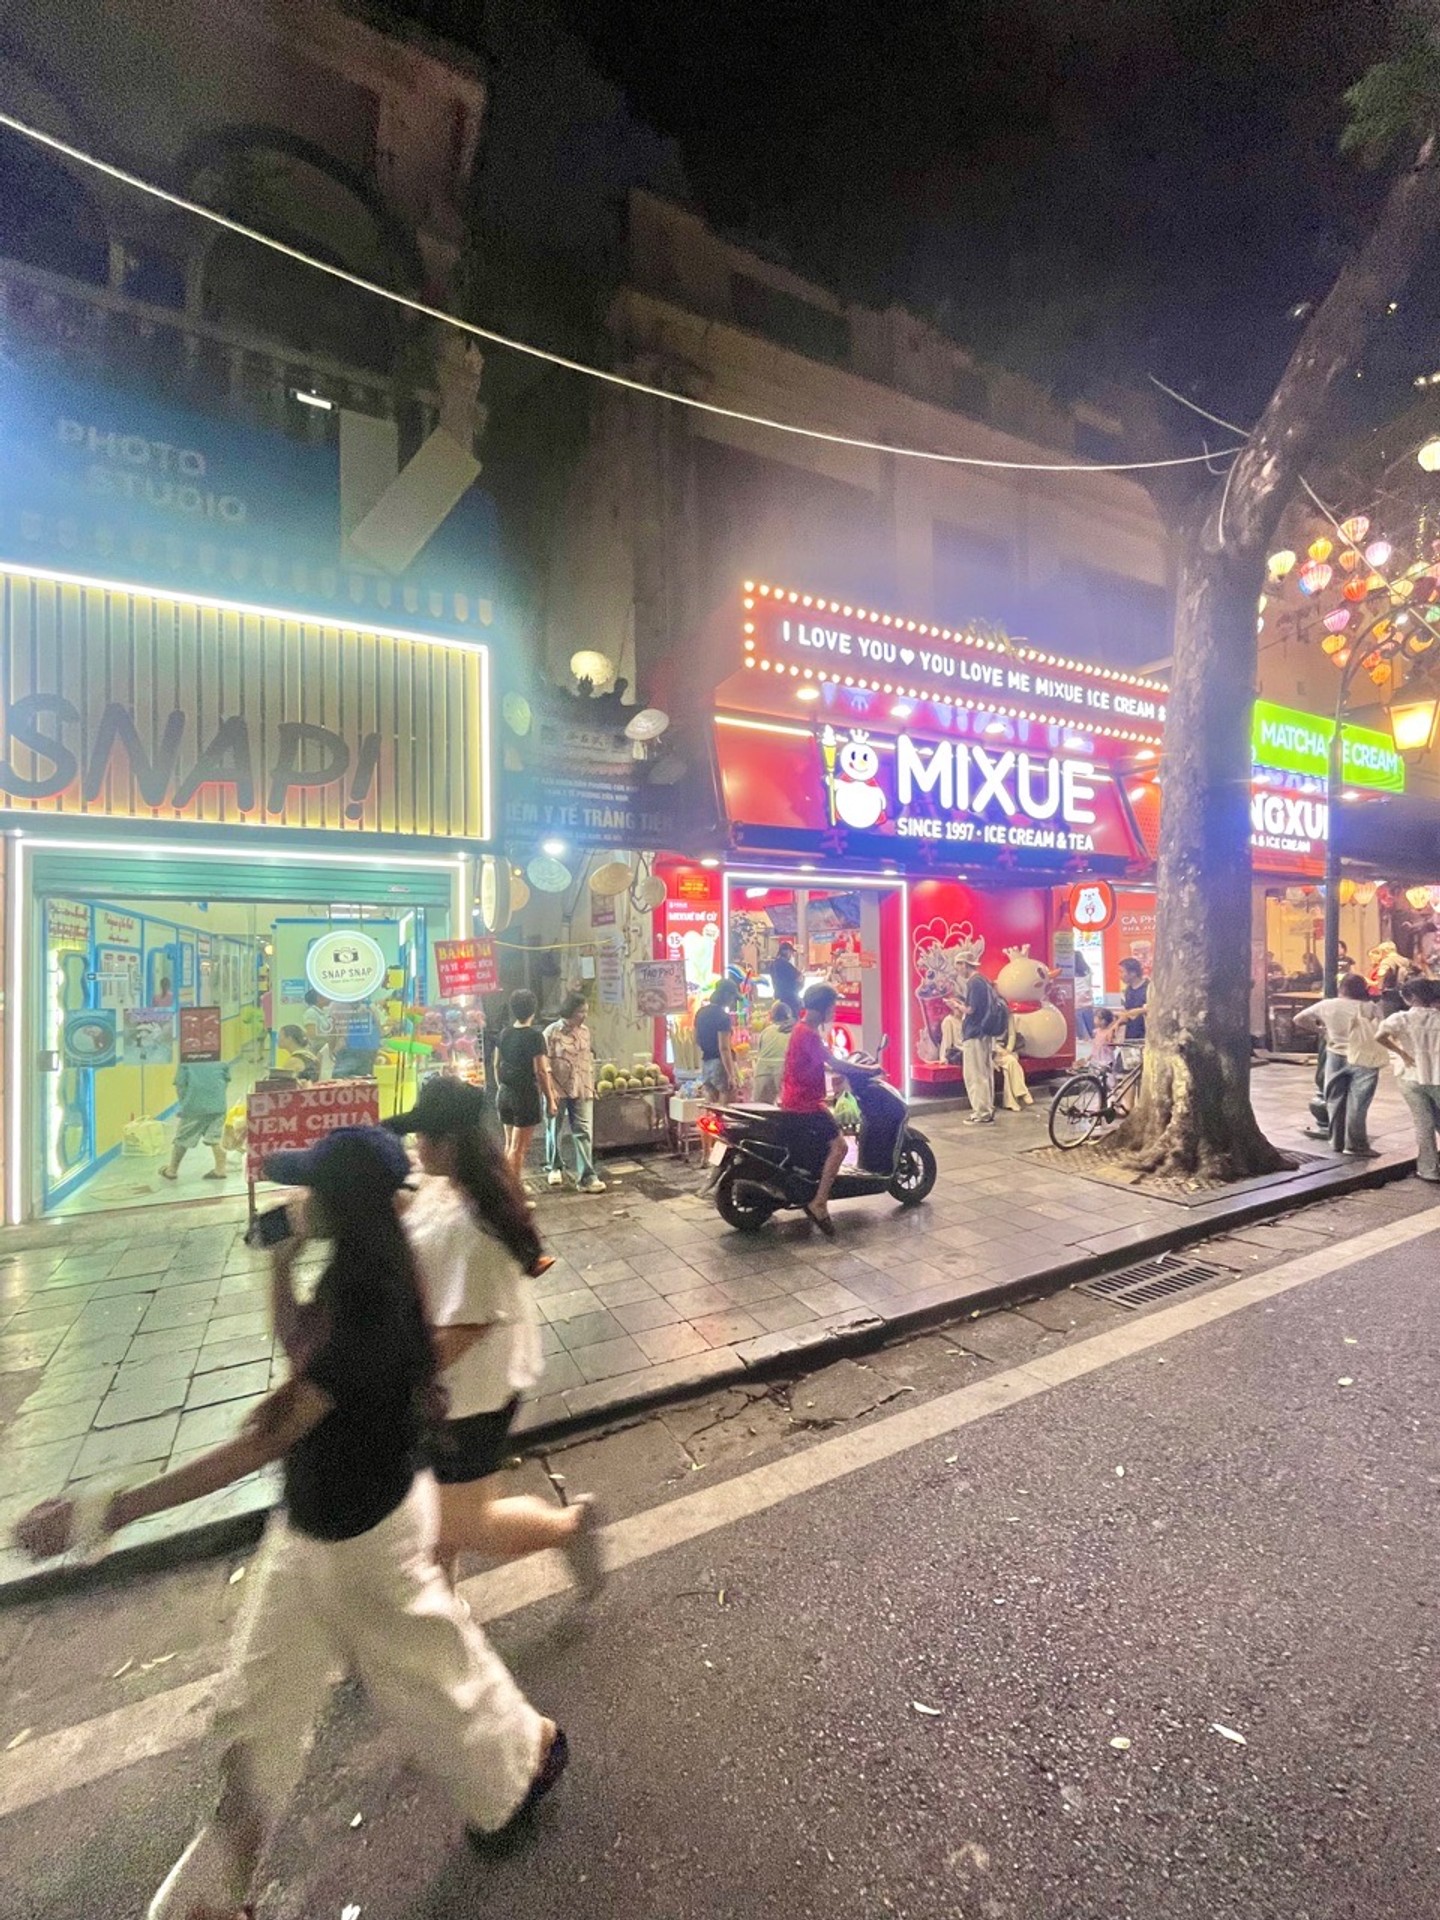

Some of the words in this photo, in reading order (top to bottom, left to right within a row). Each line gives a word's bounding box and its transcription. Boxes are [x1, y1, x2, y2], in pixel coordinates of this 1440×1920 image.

[57, 416, 206, 476] PHOTO
[88, 464, 247, 522] STUDIO
[783, 620, 791, 642] I
[799, 624, 852, 655] LOVE
[858, 636, 897, 663] YOU
[919, 651, 955, 677] YOU
[960, 660, 1004, 687] LOVE
[1008, 670, 1030, 692] ME
[1035, 677, 1083, 704] MIXUE
[1087, 689, 1110, 710] ICE
[1114, 695, 1155, 721] CREAM
[0, 692, 383, 821] SNAP!
[1260, 719, 1329, 760] MATCHA
[1351, 742, 1399, 774] CREAM
[897, 734, 1096, 824] MIXUE
[897, 817, 943, 839] SINCE
[944, 823, 975, 841] 1997
[984, 825, 1006, 845] ICE
[1008, 827, 1055, 848] CREAM
[1056, 833, 1067, 850] &
[1068, 833, 1095, 851] TEA
[1265, 835, 1281, 849] ICE
[1281, 838, 1311, 853] CREAM
[670, 936, 680, 945] 15
[322, 969, 347, 979] SNAP
[348, 967, 373, 977] SNAP
